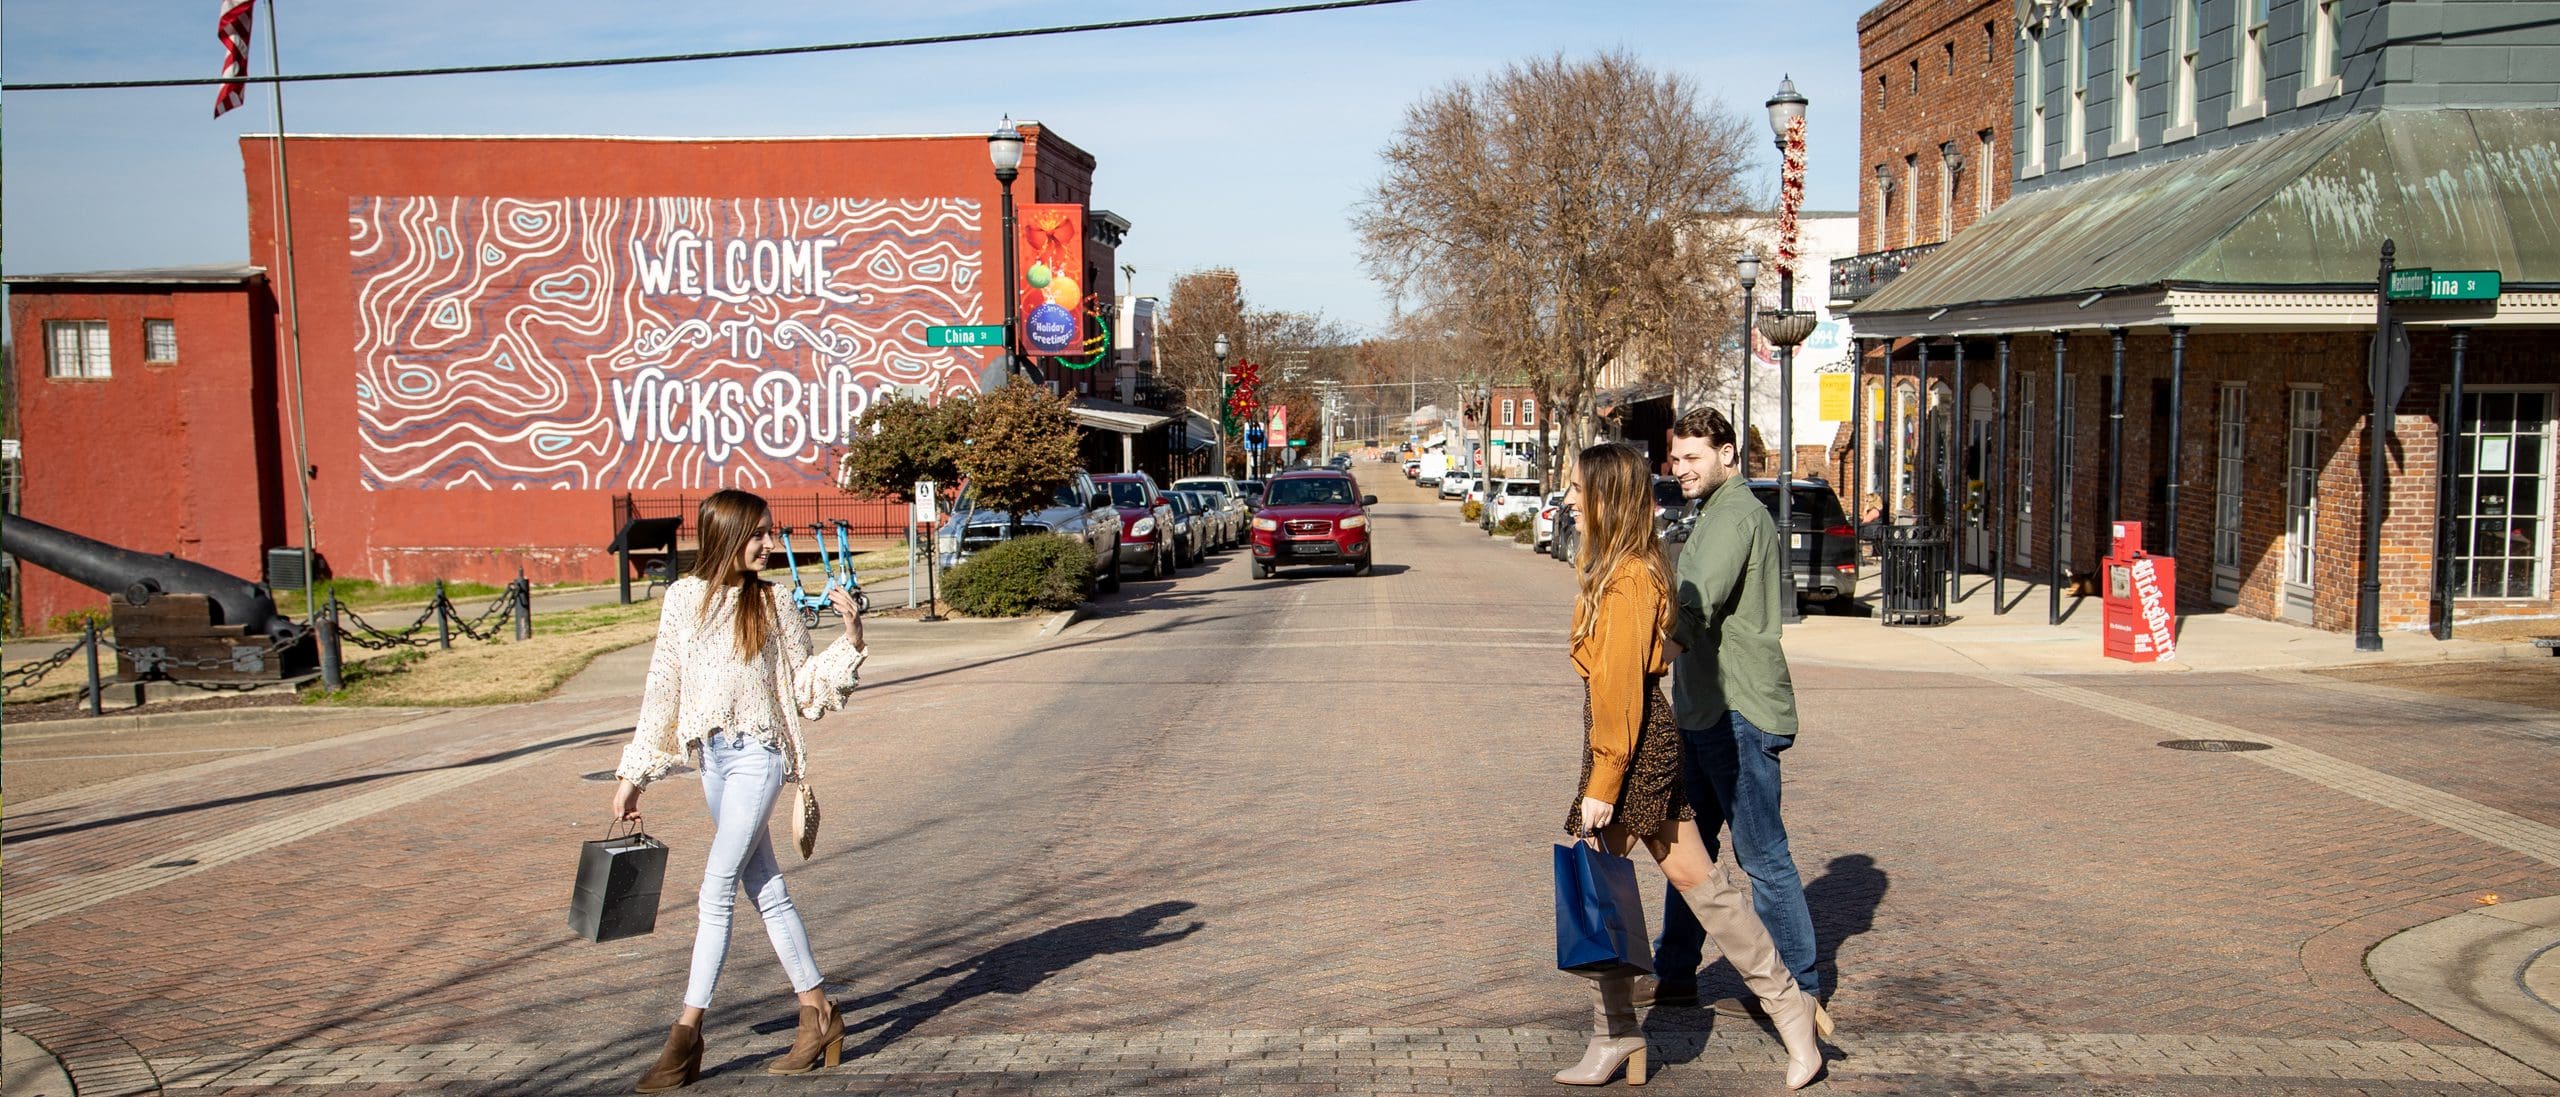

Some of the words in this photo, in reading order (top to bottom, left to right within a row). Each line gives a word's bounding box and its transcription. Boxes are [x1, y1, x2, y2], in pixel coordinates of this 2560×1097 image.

[634, 229, 861, 303] WELCOME
[2431, 276, 2458, 295] ina
[2467, 280, 2476, 290] St
[945, 329, 975, 343] China
[1036, 322, 1065, 334] Holiday
[721, 314, 764, 360] TO
[1032, 331, 1069, 345] Greetings
